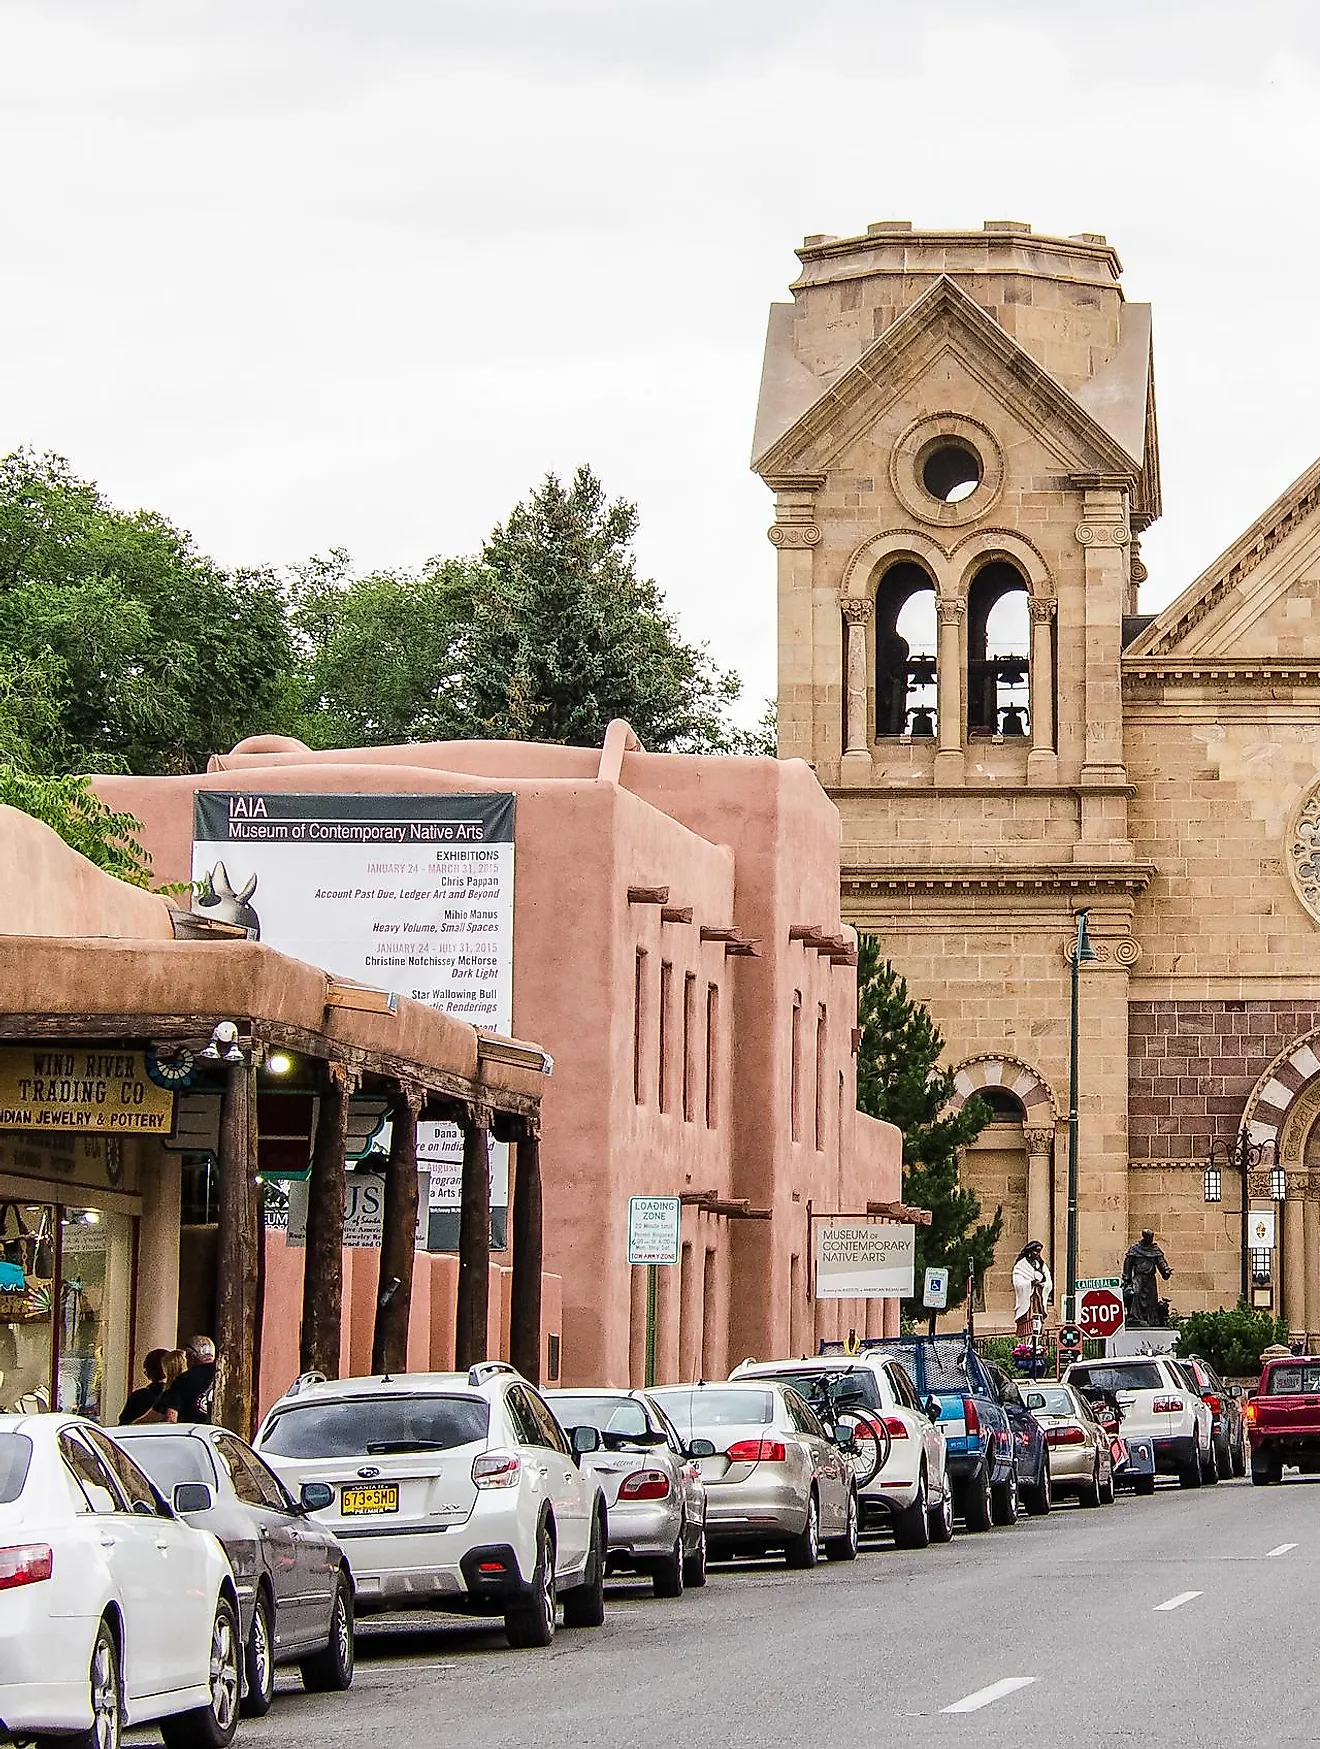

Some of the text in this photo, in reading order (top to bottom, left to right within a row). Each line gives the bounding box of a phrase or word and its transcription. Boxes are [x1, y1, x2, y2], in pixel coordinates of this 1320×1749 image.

[229, 797, 268, 817] IAIA
[229, 822, 484, 842] Museum of Contemporary Native Arts
[436, 851, 499, 861] EXHIBITIONS
[367, 863, 405, 873] JANUARY
[407, 864, 418, 873] 24
[428, 864, 460, 873] MARCH
[441, 876, 499, 888] Chris Pappan
[315, 889, 500, 901] Account Past Due, Ledger Art and Beyond
[469, 910, 498, 919] Manus
[373, 923, 499, 934] Heavy Volume, Small Spaces
[376, 943, 415, 954] JANUARY
[418, 943, 429, 953] 24
[475, 943, 498, 953] 2015
[365, 956, 405, 966] Christine
[458, 956, 497, 966] McHorse
[451, 968, 498, 980] Dark Light
[411, 990, 497, 1000] Star Wallowing Bull
[446, 1002, 497, 1013] Renderings
[33, 1053, 135, 1078] WIND RIVER
[19, 1078, 145, 1104] TRADING CO
[35, 1110, 91, 1125] JEWELRY
[97, 1113, 105, 1125] &
[110, 1112, 164, 1127] POTTERY
[435, 1129, 457, 1138] Dana
[438, 1188, 456, 1198] Arts
[635, 1201, 674, 1210] LOADING
[642, 1212, 666, 1220] ZONE
[823, 1230, 869, 1240] MUSEUM
[822, 1241, 911, 1251] CONTEMPORARY
[822, 1252, 886, 1262] NATIVE ARTS
[1077, 1280, 1111, 1289] CATHEDRAL
[1081, 1304, 1120, 1323] STOP
